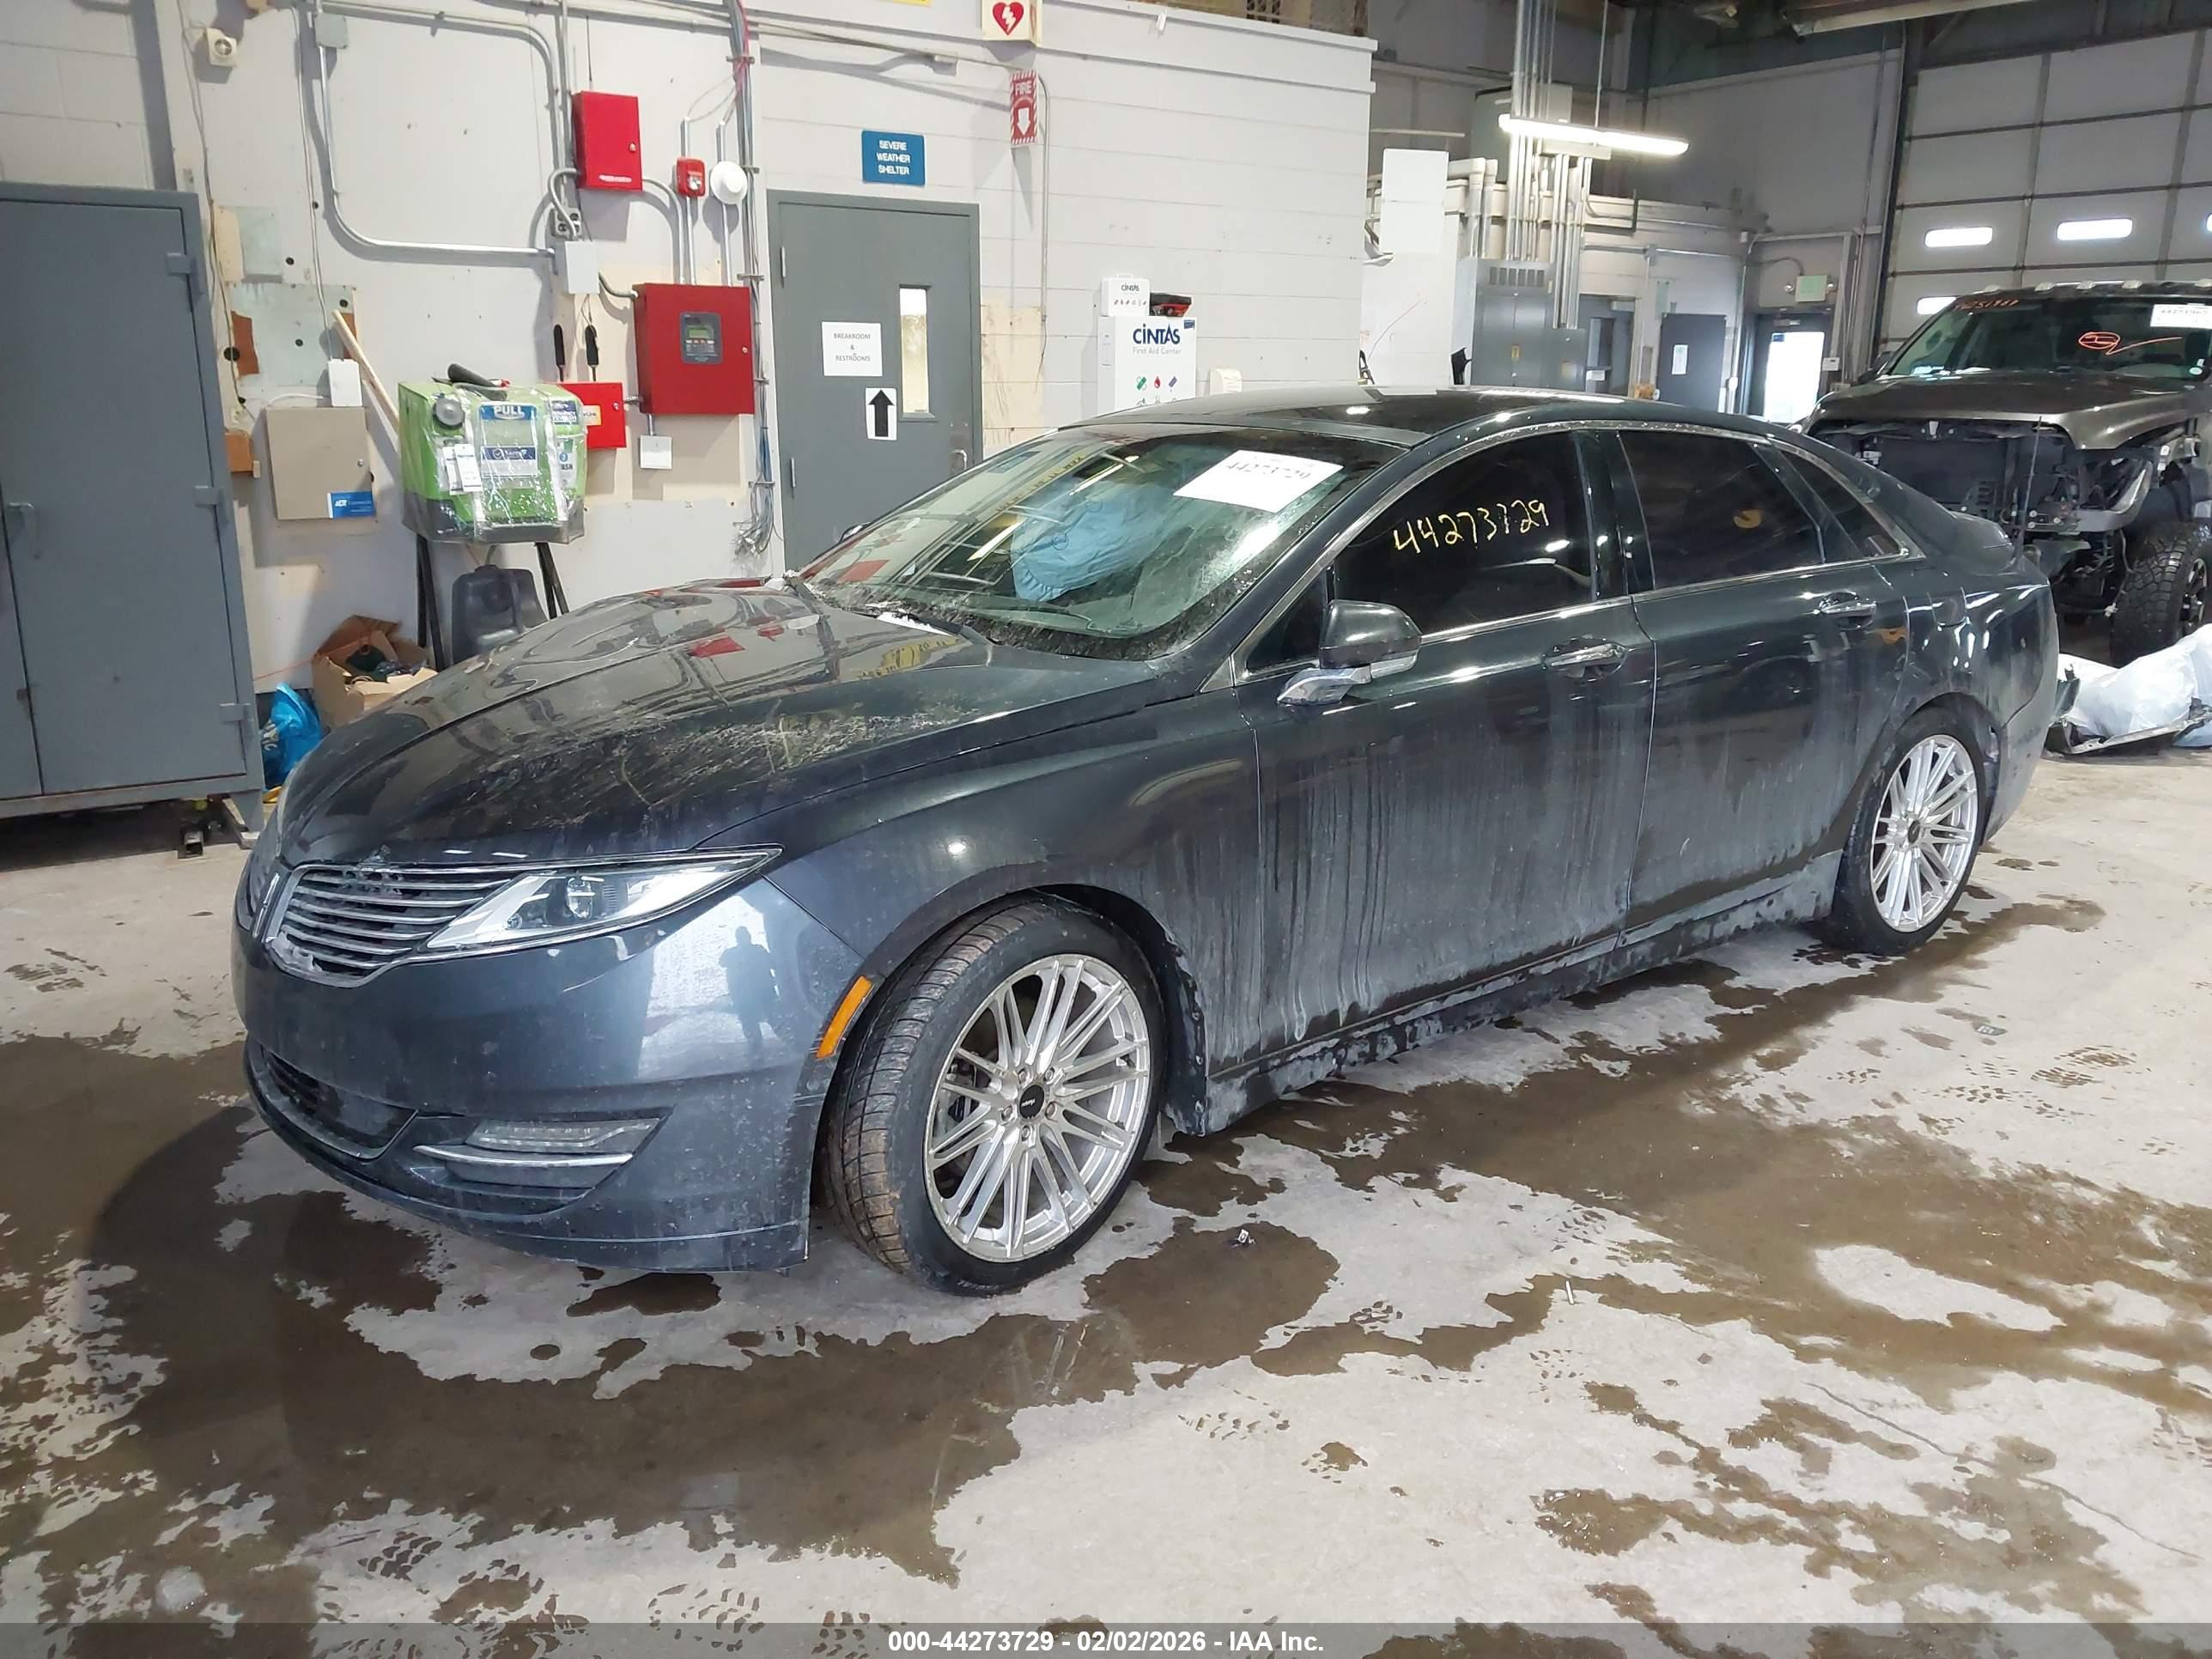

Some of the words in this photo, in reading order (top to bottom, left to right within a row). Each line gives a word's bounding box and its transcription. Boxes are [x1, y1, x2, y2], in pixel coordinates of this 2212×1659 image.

[1015, 81, 1032, 95] FIRE
[878, 140, 908, 151] SEVERE
[876, 152, 911, 163] WEATHER
[878, 164, 910, 175] SHELTER
[1161, 347, 1182, 356] Center
[494, 404, 522, 414] PULL
[1393, 500, 1549, 554] 44273729
